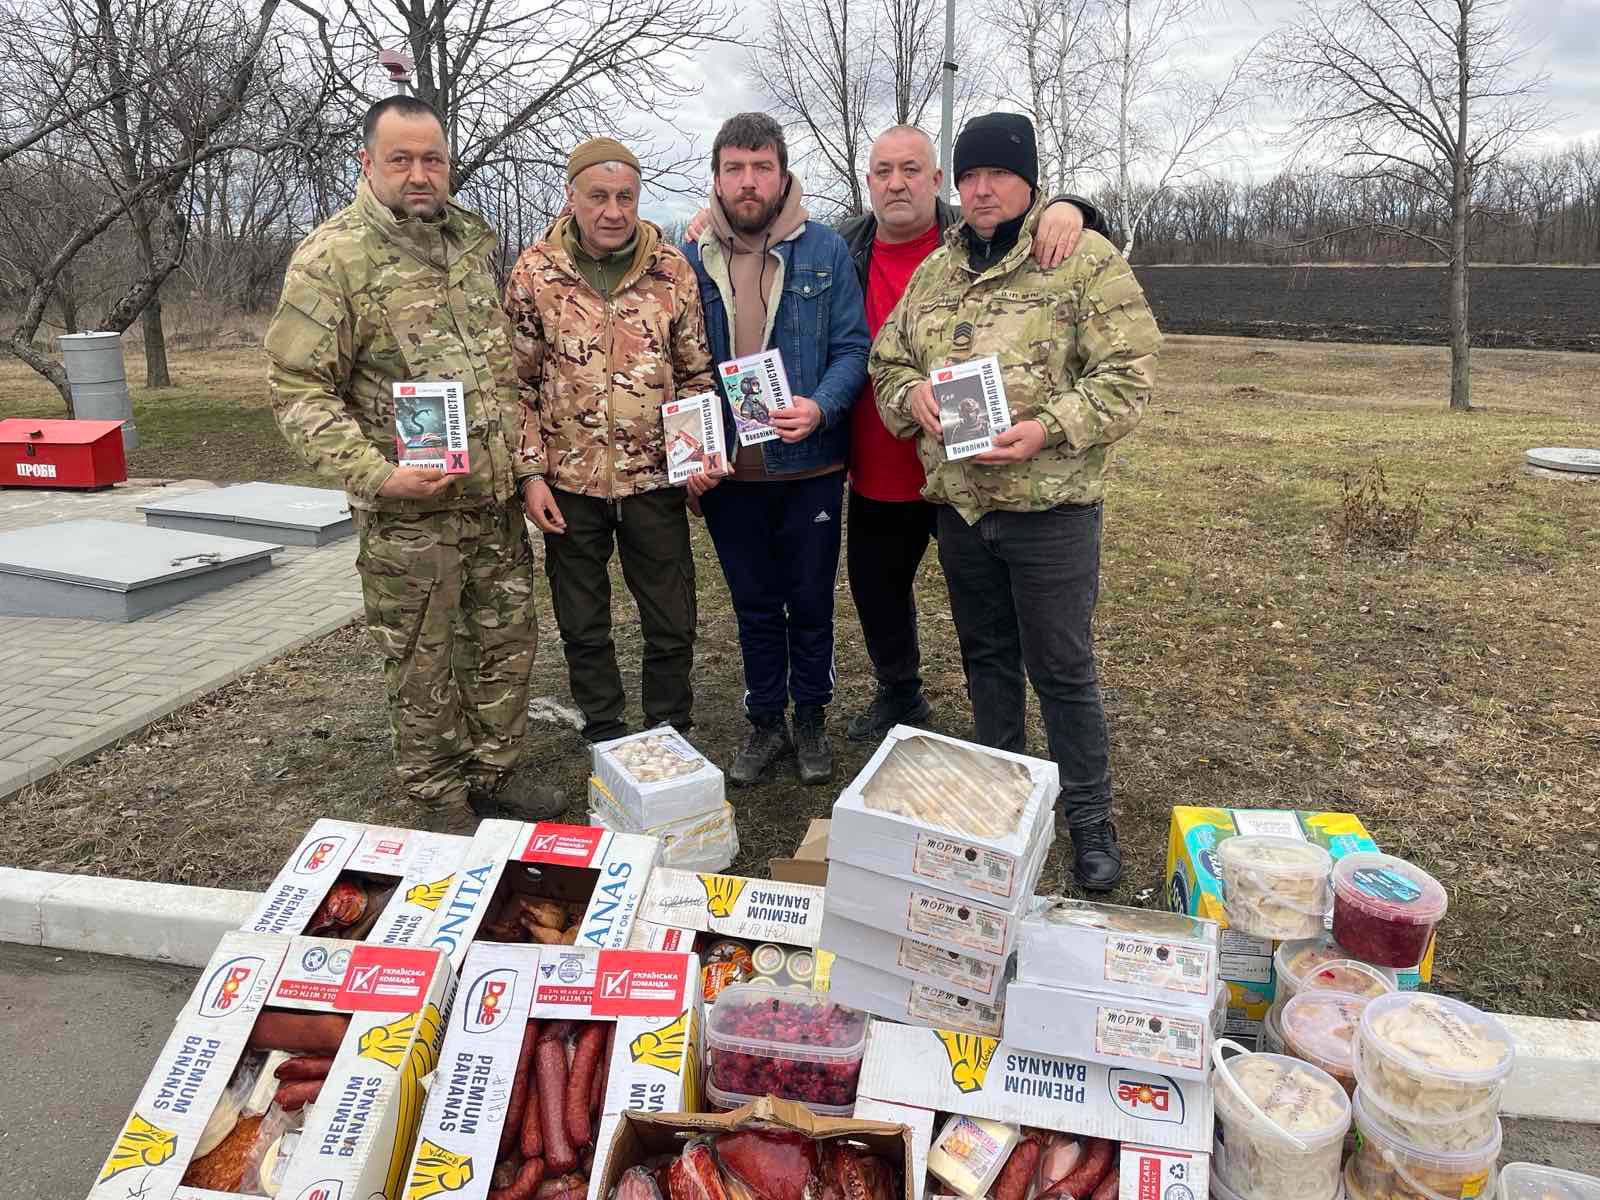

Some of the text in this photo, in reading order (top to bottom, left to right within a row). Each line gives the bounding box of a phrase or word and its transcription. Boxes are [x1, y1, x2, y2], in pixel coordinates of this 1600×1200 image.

[764, 358, 787, 410] УРНАЛІСТКА
[446, 388, 462, 448] ЖУРНАЛІСТКА
[254, 884, 294, 933] BANANAS
[430, 864, 493, 957] ONITA
[583, 862, 632, 947] ANAS
[748, 905, 807, 925] PREMIUM
[750, 889, 810, 911] BANANAS
[383, 914, 410, 944] MIUM
[399, 915, 423, 944] ANAS
[379, 975, 416, 985] КОМАНДА
[383, 967, 426, 977] УКРАЇНСЬКА
[631, 979, 669, 988] КОМАНДА
[632, 971, 679, 980] УКРАЇНСЬКА
[153, 1035, 202, 1110] BANANAS
[171, 1039, 221, 1114] PREMIUM
[1007, 1053, 1087, 1083] BANANAS
[439, 1052, 473, 1132] BANANAS
[459, 1054, 493, 1135] PREMIUM
[1004, 1074, 1085, 1104] PREMIUM
[1117, 1084, 1169, 1112] Dole
[319, 1075, 365, 1155] PREMIUM
[338, 1076, 382, 1157] BANANAS
